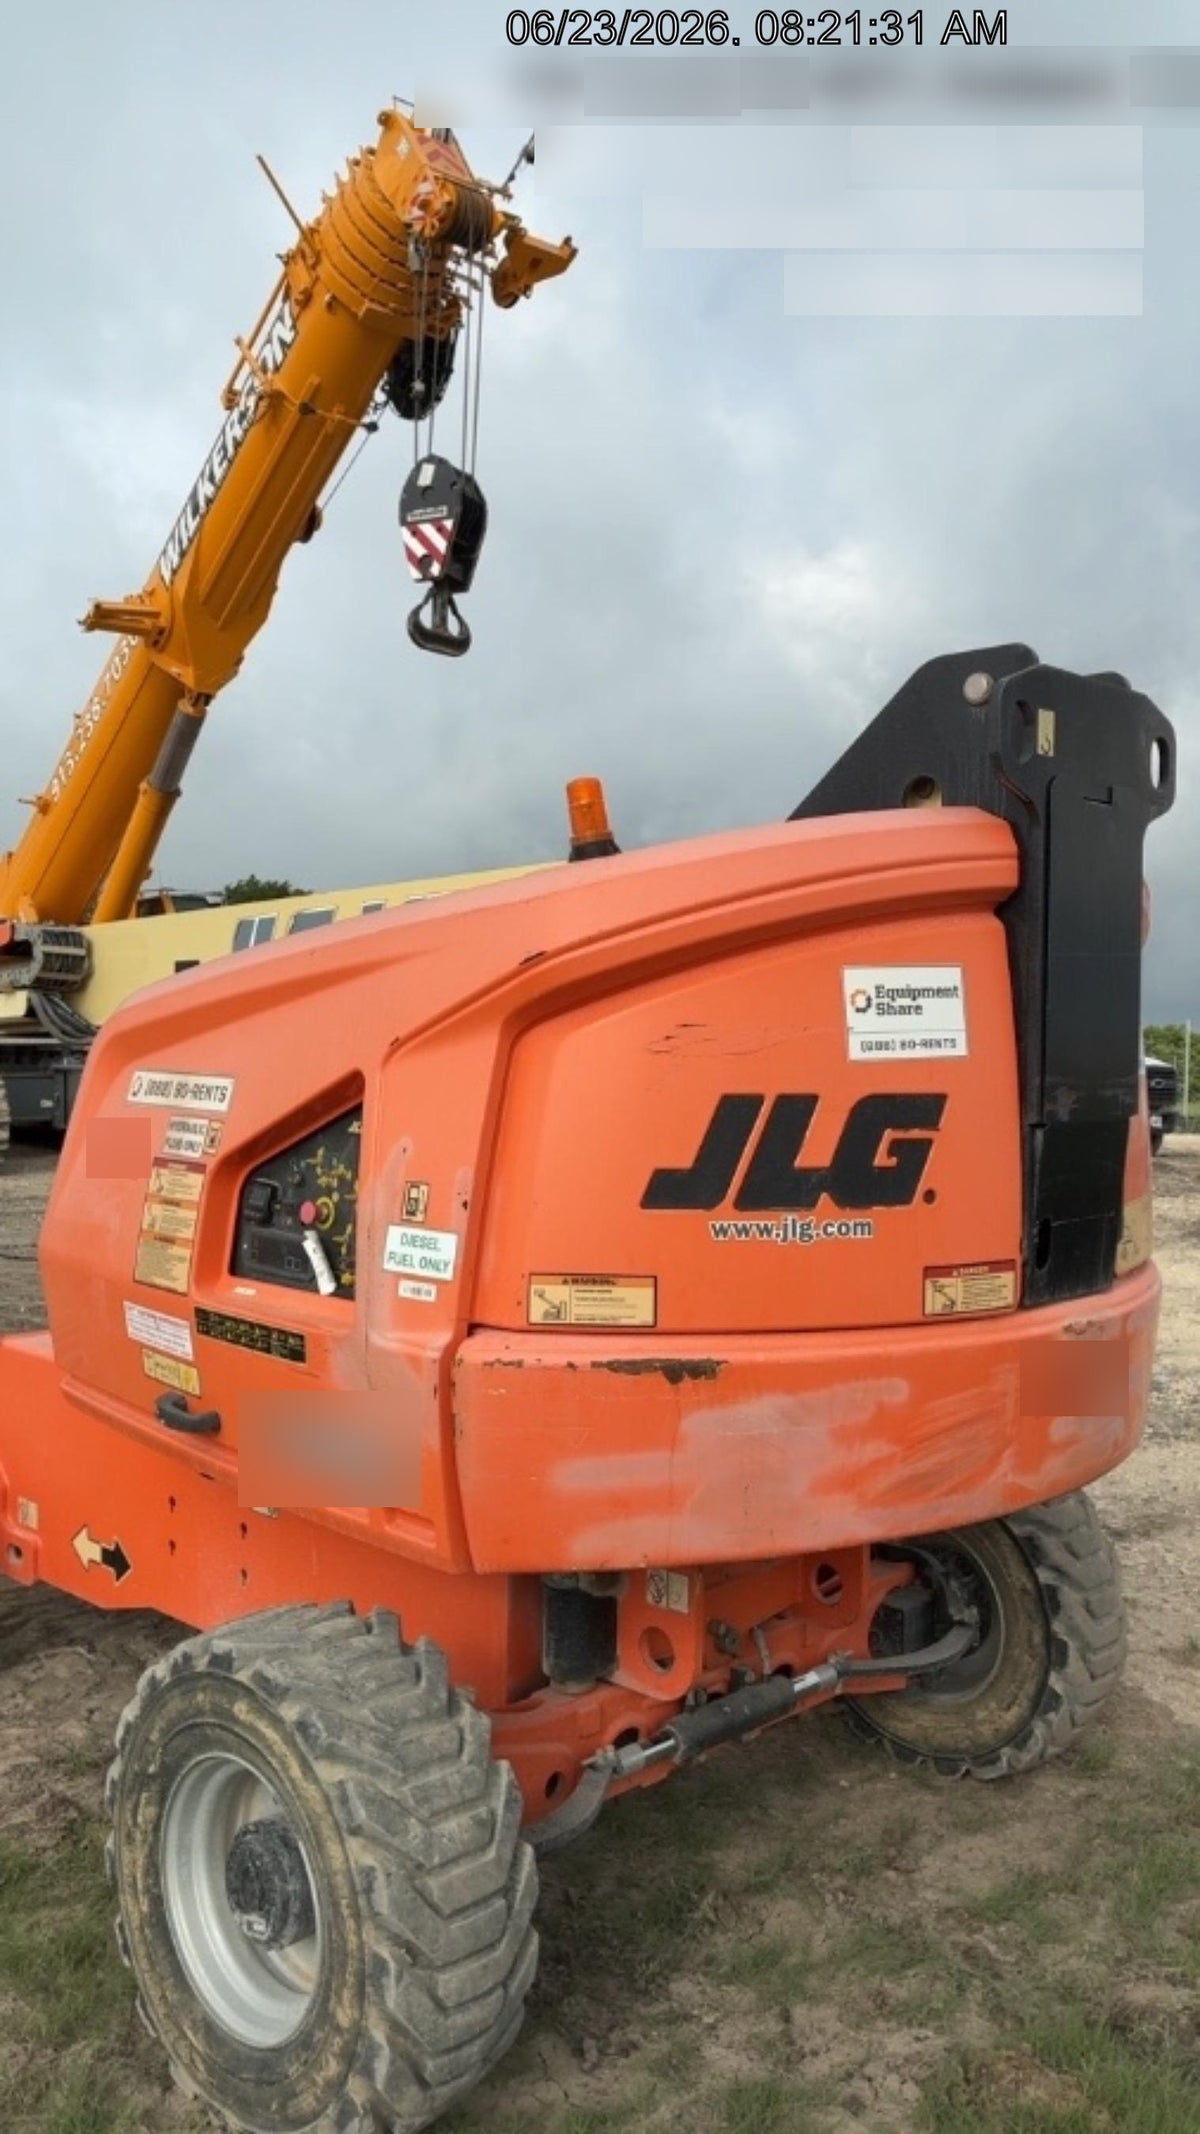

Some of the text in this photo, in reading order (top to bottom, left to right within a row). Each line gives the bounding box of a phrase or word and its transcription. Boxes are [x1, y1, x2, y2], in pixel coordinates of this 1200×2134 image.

[875, 984, 960, 1002] Equipment
[876, 1003, 923, 1016] Share
[640, 1093, 947, 1211] JLG
[711, 1218, 873, 1244] www.jlg.com
[400, 1232, 441, 1252] DIESEL
[387, 1251, 451, 1274] FUEL ONLY
